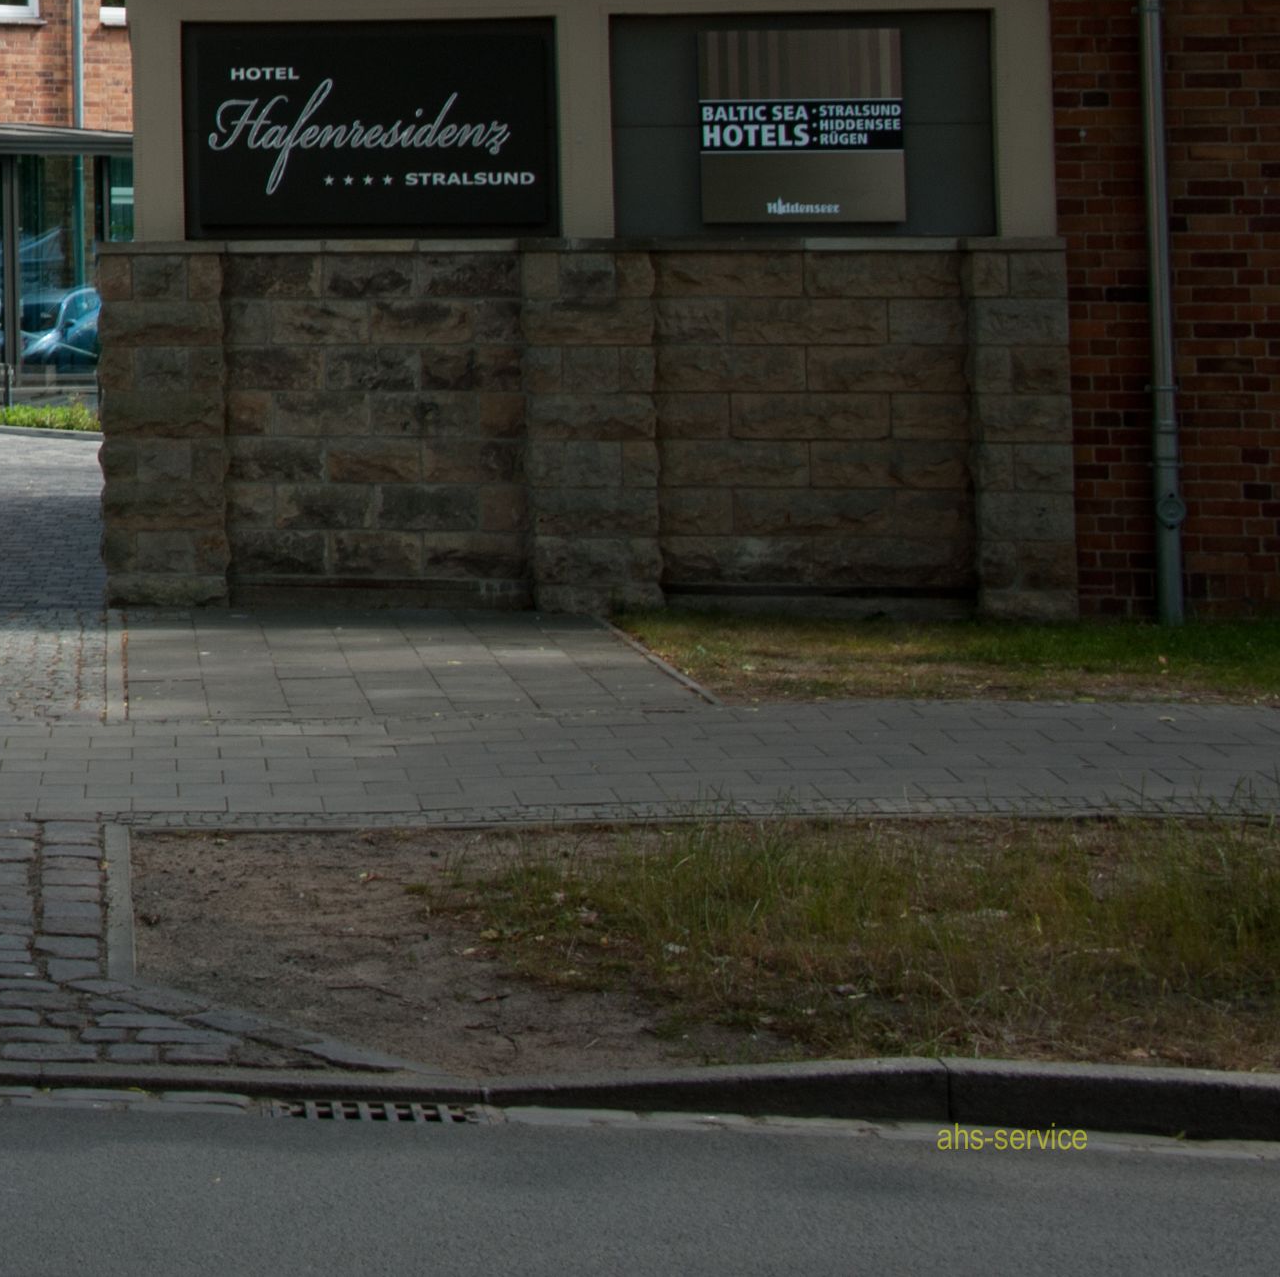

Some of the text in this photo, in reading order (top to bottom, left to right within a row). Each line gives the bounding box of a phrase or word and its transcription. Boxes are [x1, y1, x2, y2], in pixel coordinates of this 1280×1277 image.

[231, 67, 299, 80] HOTEL
[702, 105, 808, 122] BALTIC SEA
[819, 104, 901, 117] STRALSUND
[819, 119, 901, 131] HIDDENSEE
[208, 78, 510, 195] Hafenresidenz
[703, 124, 809, 147] HOTELS
[819, 131, 868, 145] RÜGEN
[405, 172, 535, 185] STRALSUND
